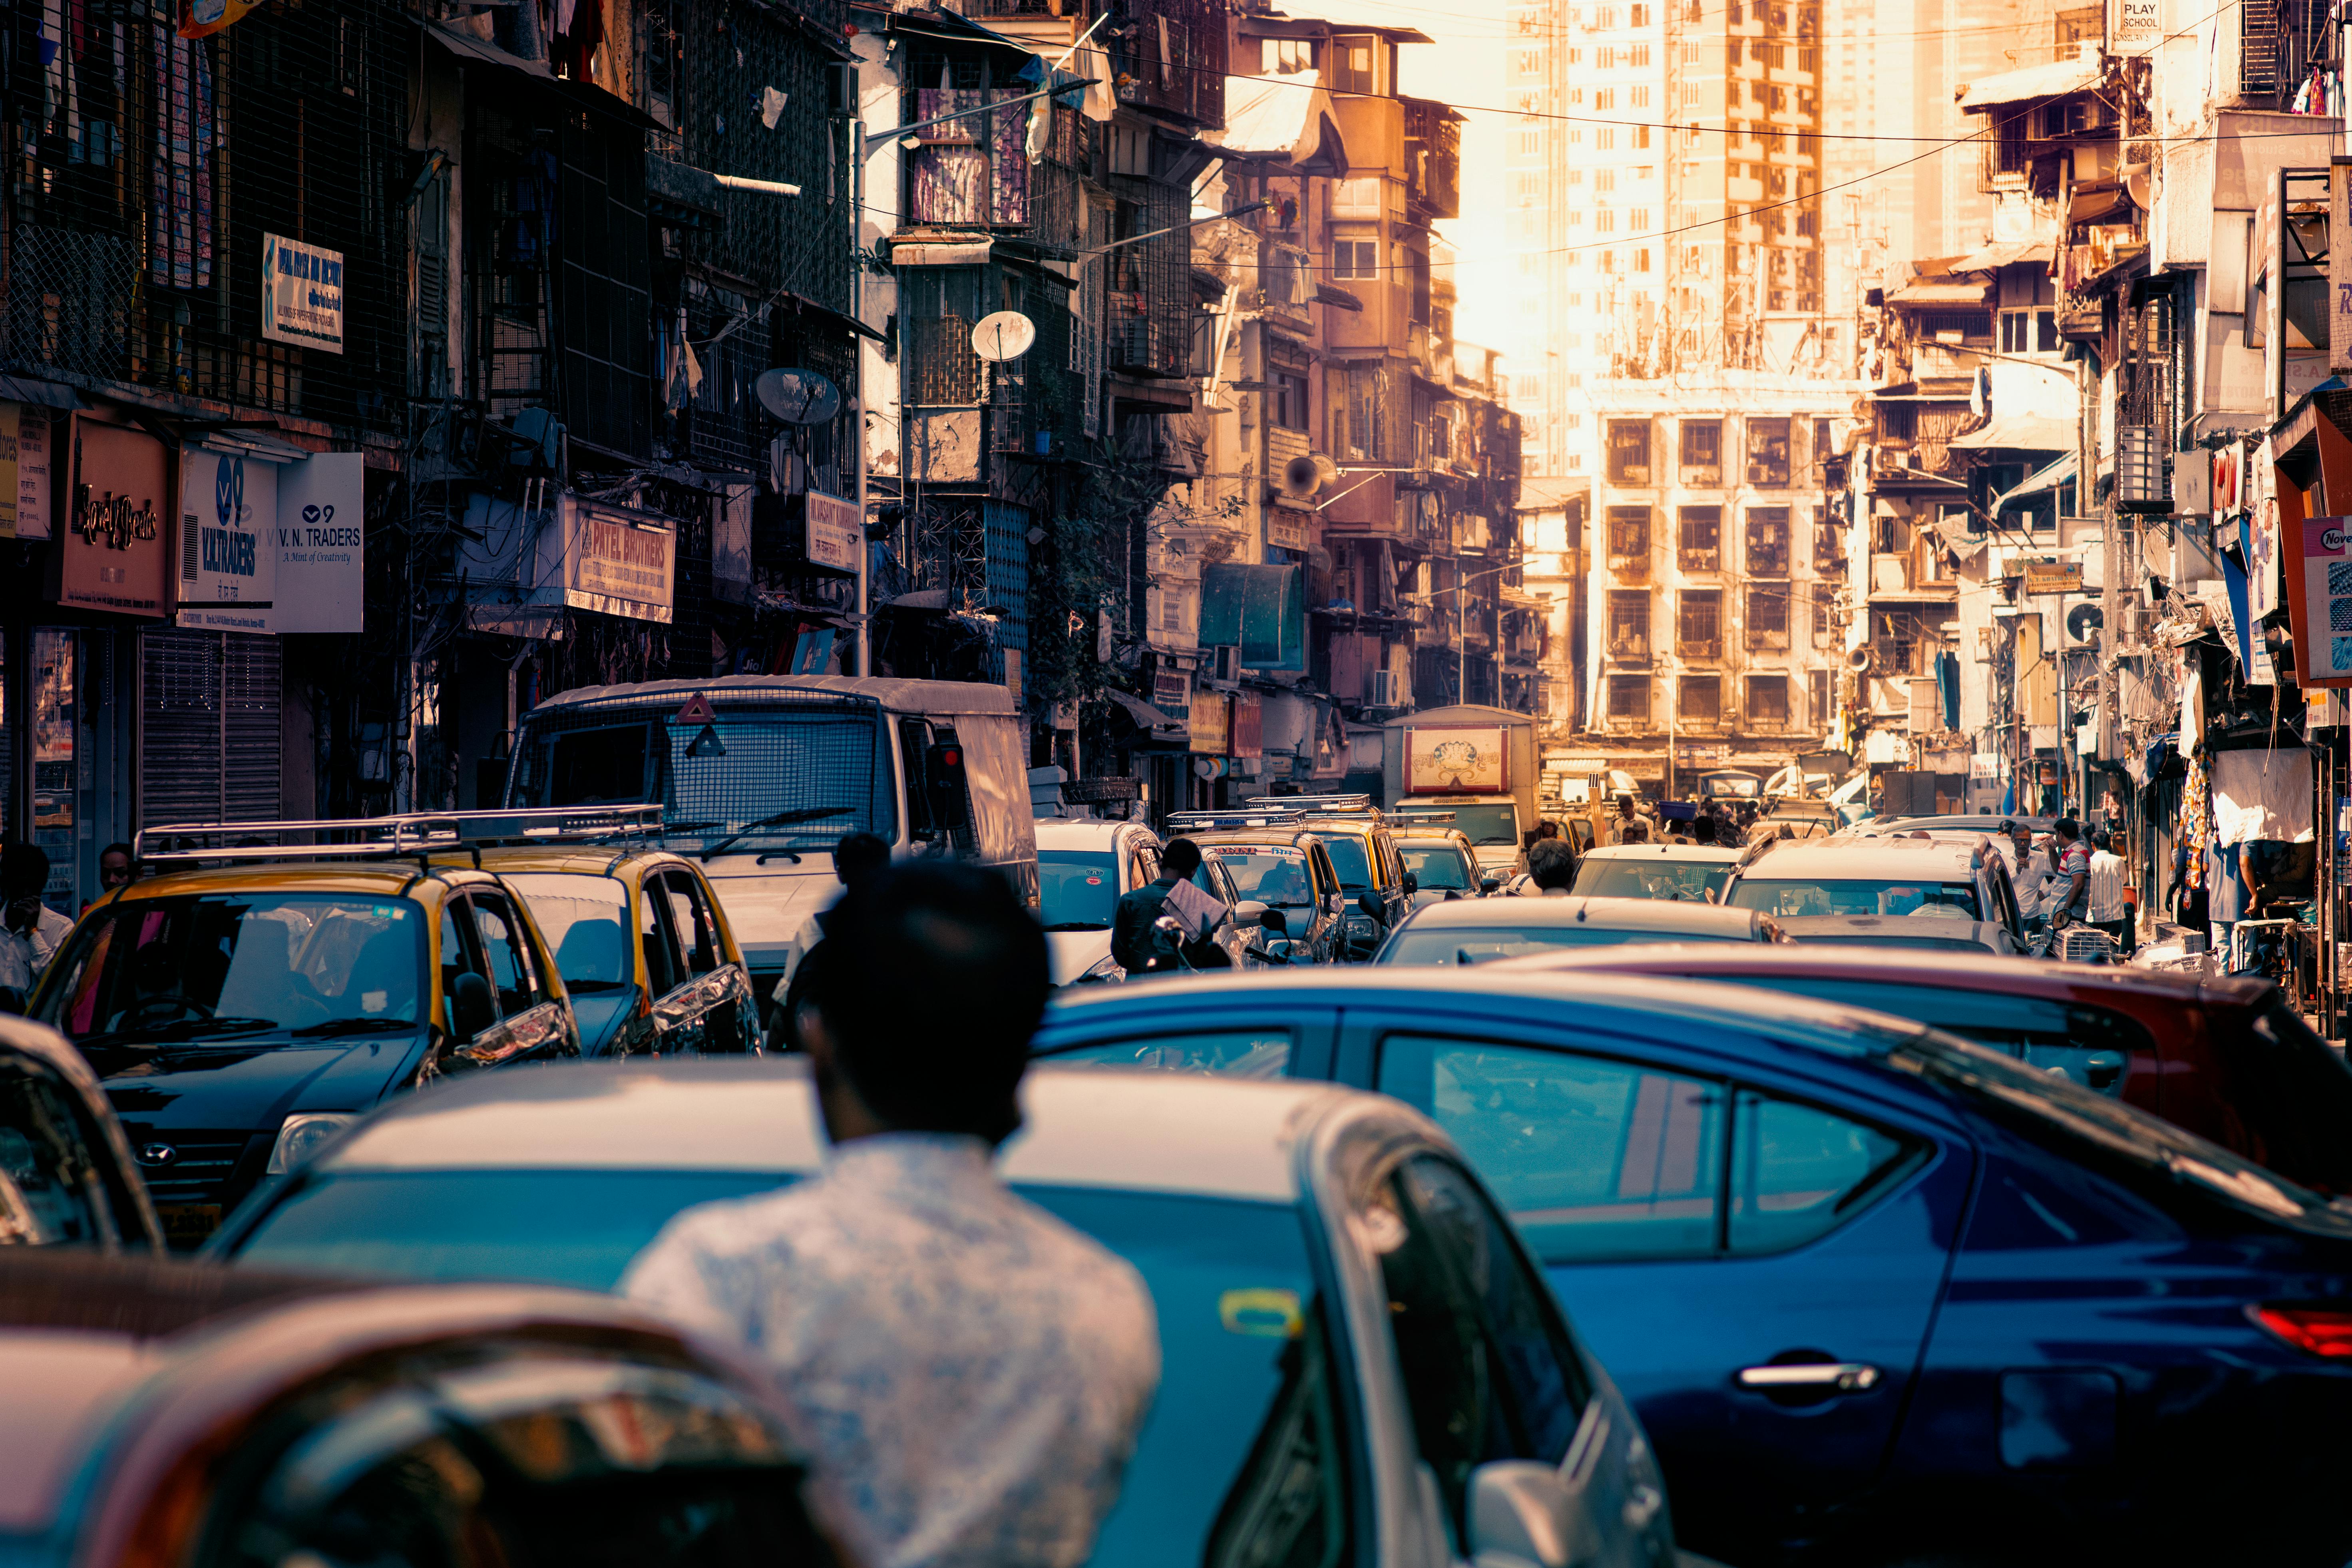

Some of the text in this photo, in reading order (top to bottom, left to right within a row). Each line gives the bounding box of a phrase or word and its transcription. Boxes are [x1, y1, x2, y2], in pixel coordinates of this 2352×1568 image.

[2125, 4, 2156, 14] PLAY
[2123, 18, 2157, 27] SCHOOL
[283, 305, 292, 318] KINDS
[293, 308, 296, 319] OF
[318, 314, 334, 327] PACKAGING
[279, 528, 360, 547] V. N. TRADERS
[593, 522, 666, 571] PATEL BROTHERS
[283, 551, 350, 565] A Mint of Creativity
[743, 658, 759, 671] Jio
[803, 646, 813, 671] Jio
[1212, 847, 1258, 856] ALINI
